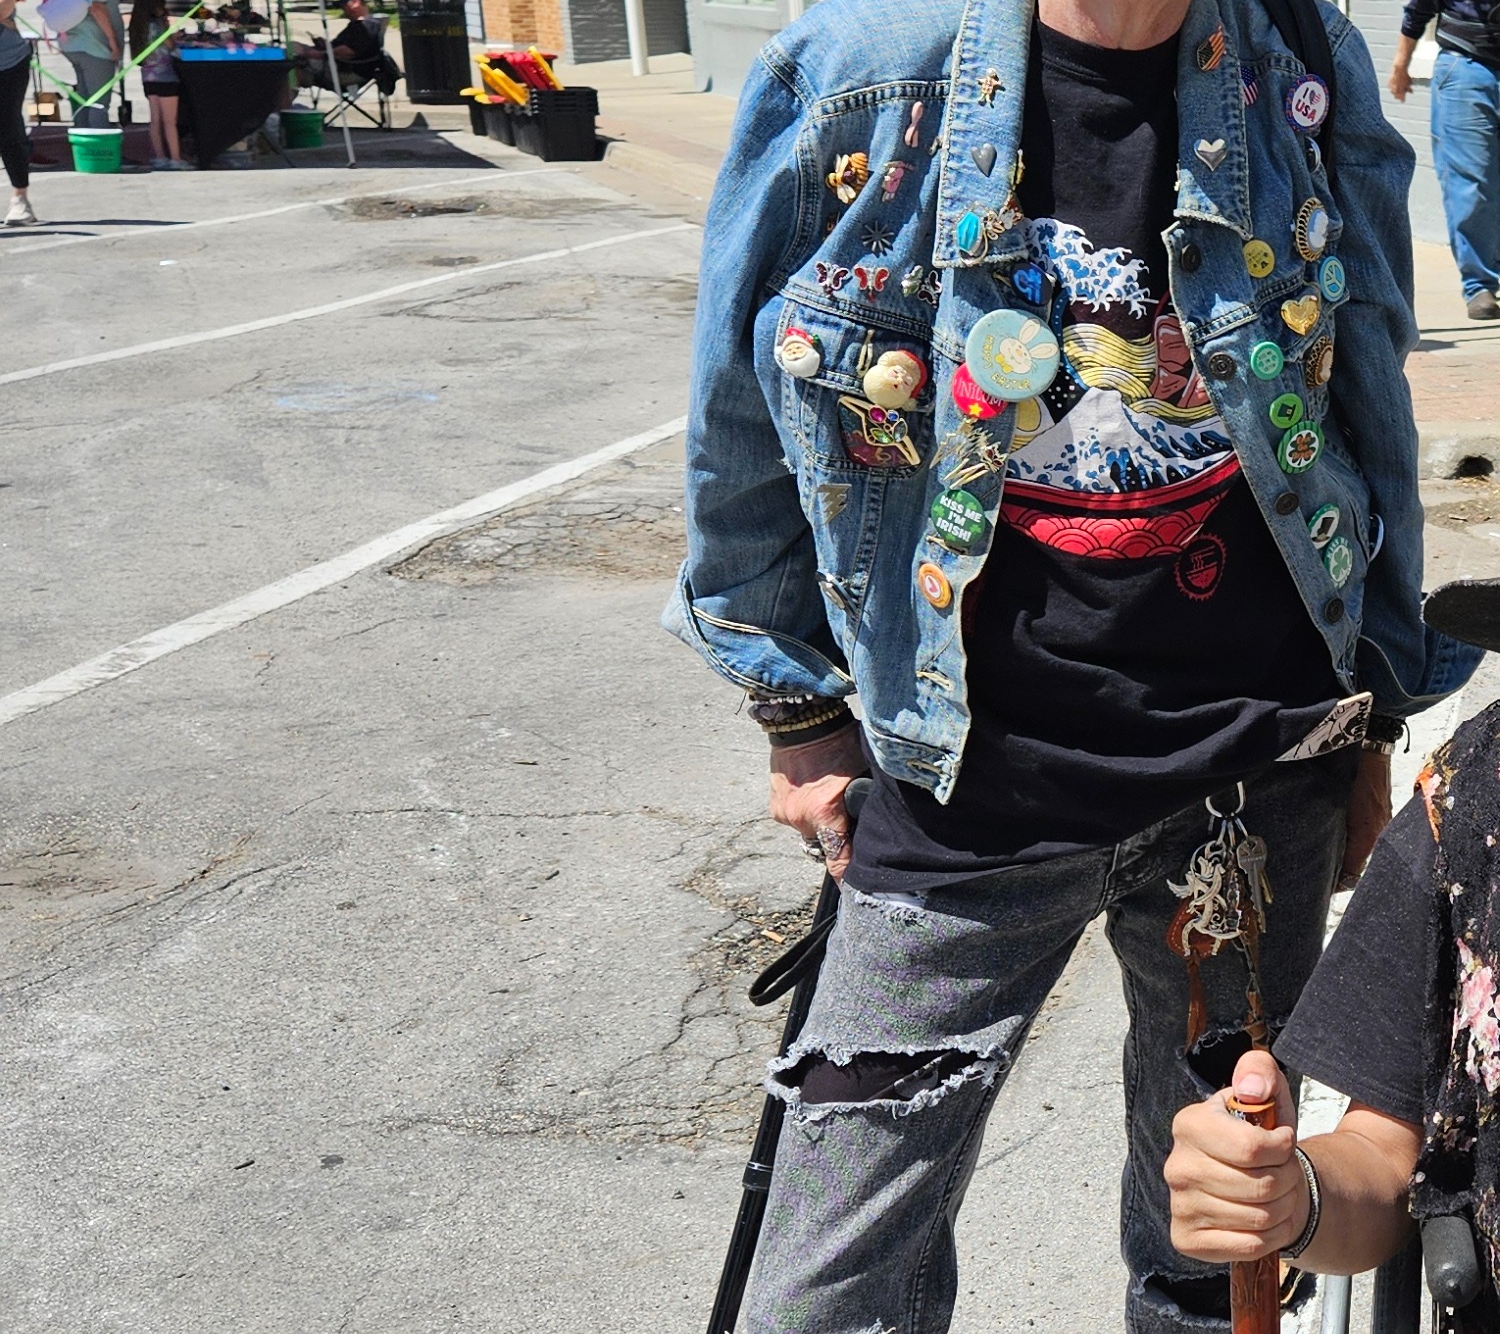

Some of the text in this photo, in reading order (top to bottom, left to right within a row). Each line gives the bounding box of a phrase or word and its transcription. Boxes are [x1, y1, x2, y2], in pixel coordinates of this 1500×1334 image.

[1295, 99, 1317, 122] USA
[940, 495, 982, 523] KISS ME
[948, 510, 966, 526] I'M
